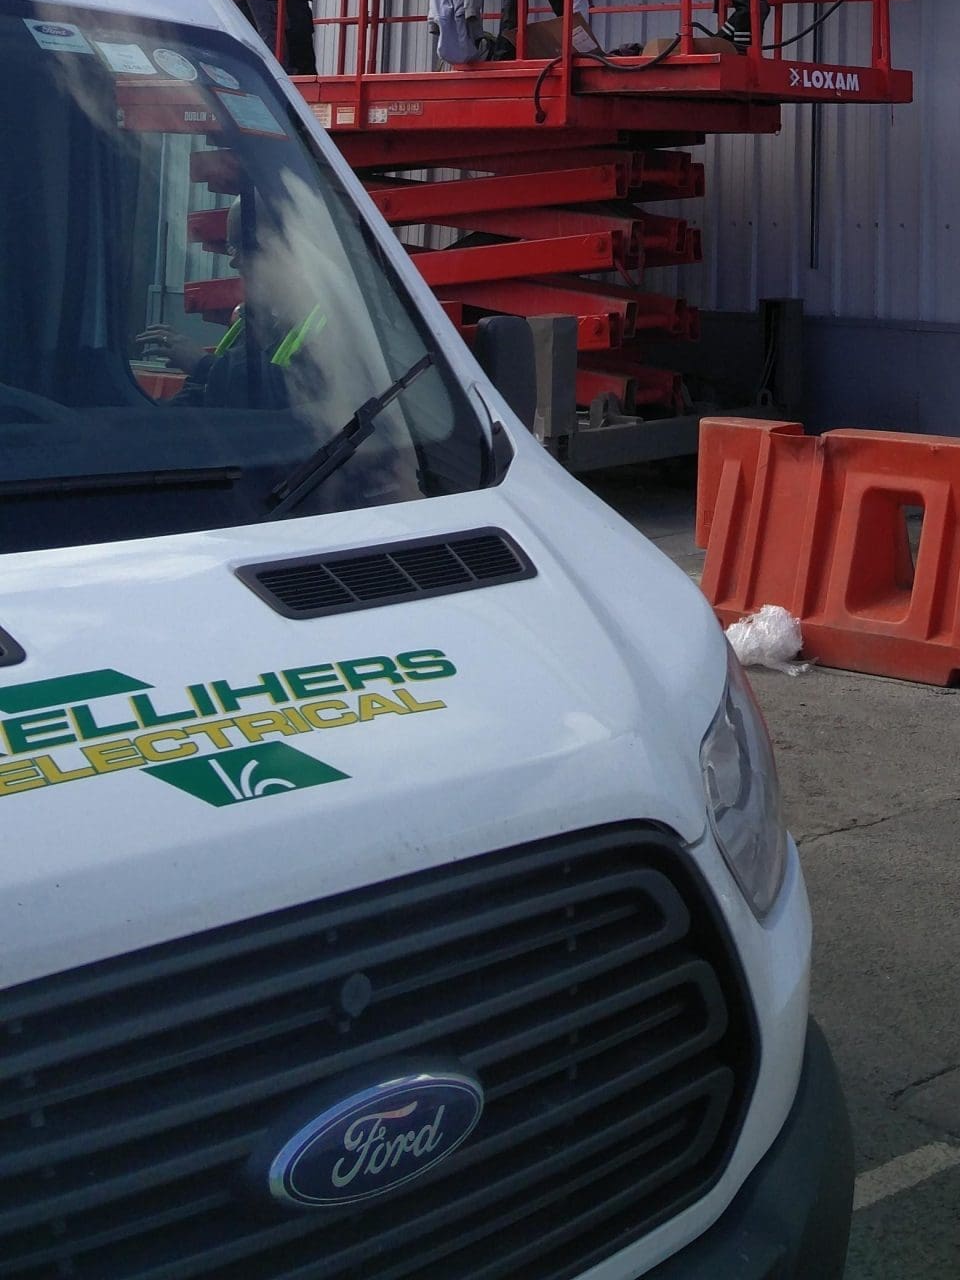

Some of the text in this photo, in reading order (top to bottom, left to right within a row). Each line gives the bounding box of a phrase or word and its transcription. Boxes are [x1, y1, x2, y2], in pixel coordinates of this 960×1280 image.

[803, 69, 860, 91] LOXAM
[0, 648, 458, 757] ELLIHERS
[0, 688, 447, 797] ELECTRICAL
[331, 1100, 446, 1188] Ford
